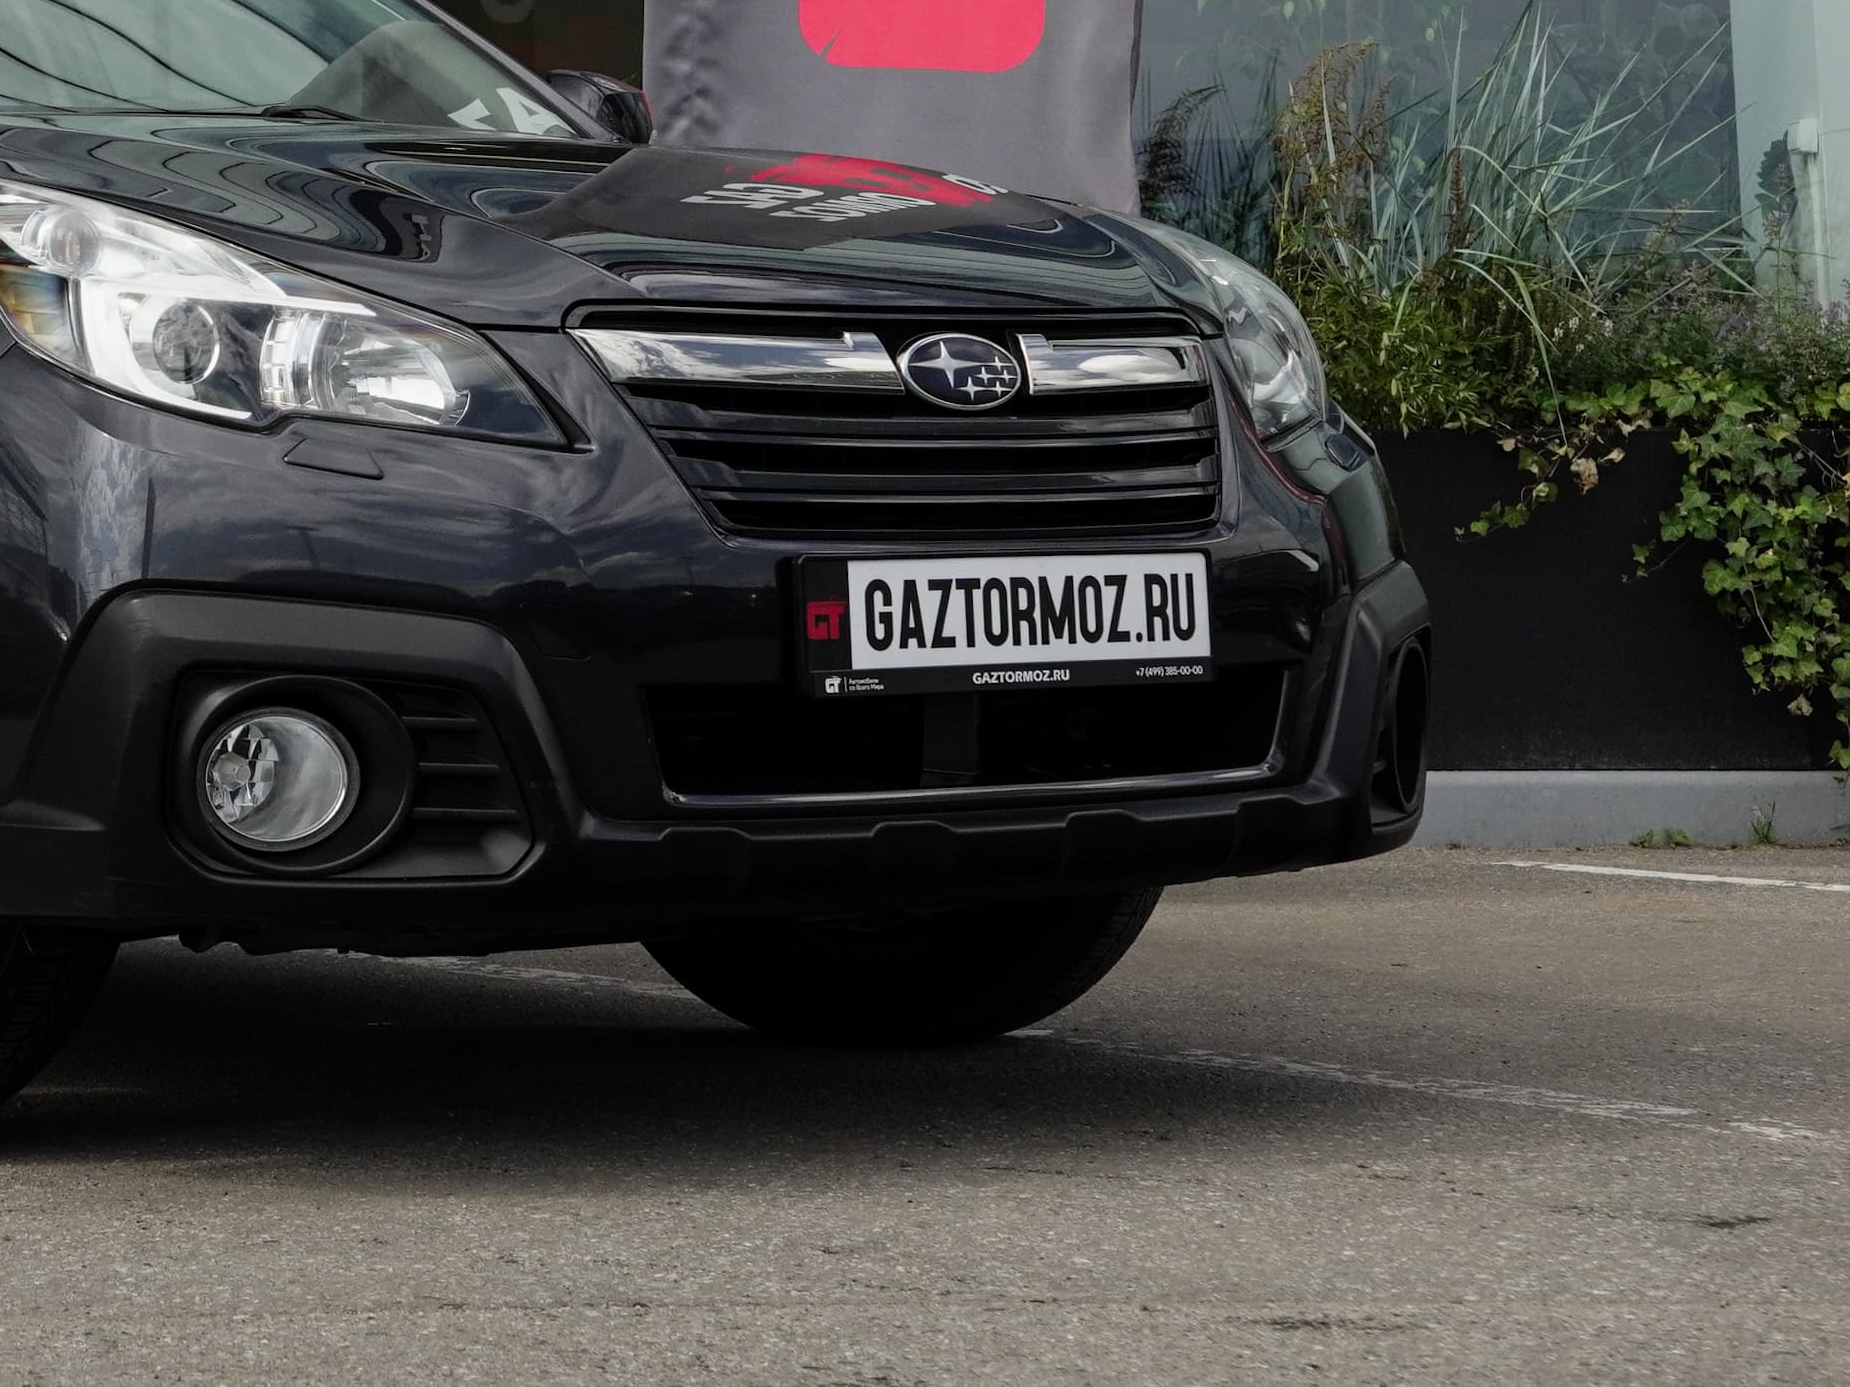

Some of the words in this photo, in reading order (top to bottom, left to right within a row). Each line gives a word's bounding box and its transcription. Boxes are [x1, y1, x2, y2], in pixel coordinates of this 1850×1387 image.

[806, 599, 847, 641] GT
[864, 573, 1197, 652] GAZTORMOZ.RU
[972, 668, 1070, 685] GAZTORMOZ.RU
